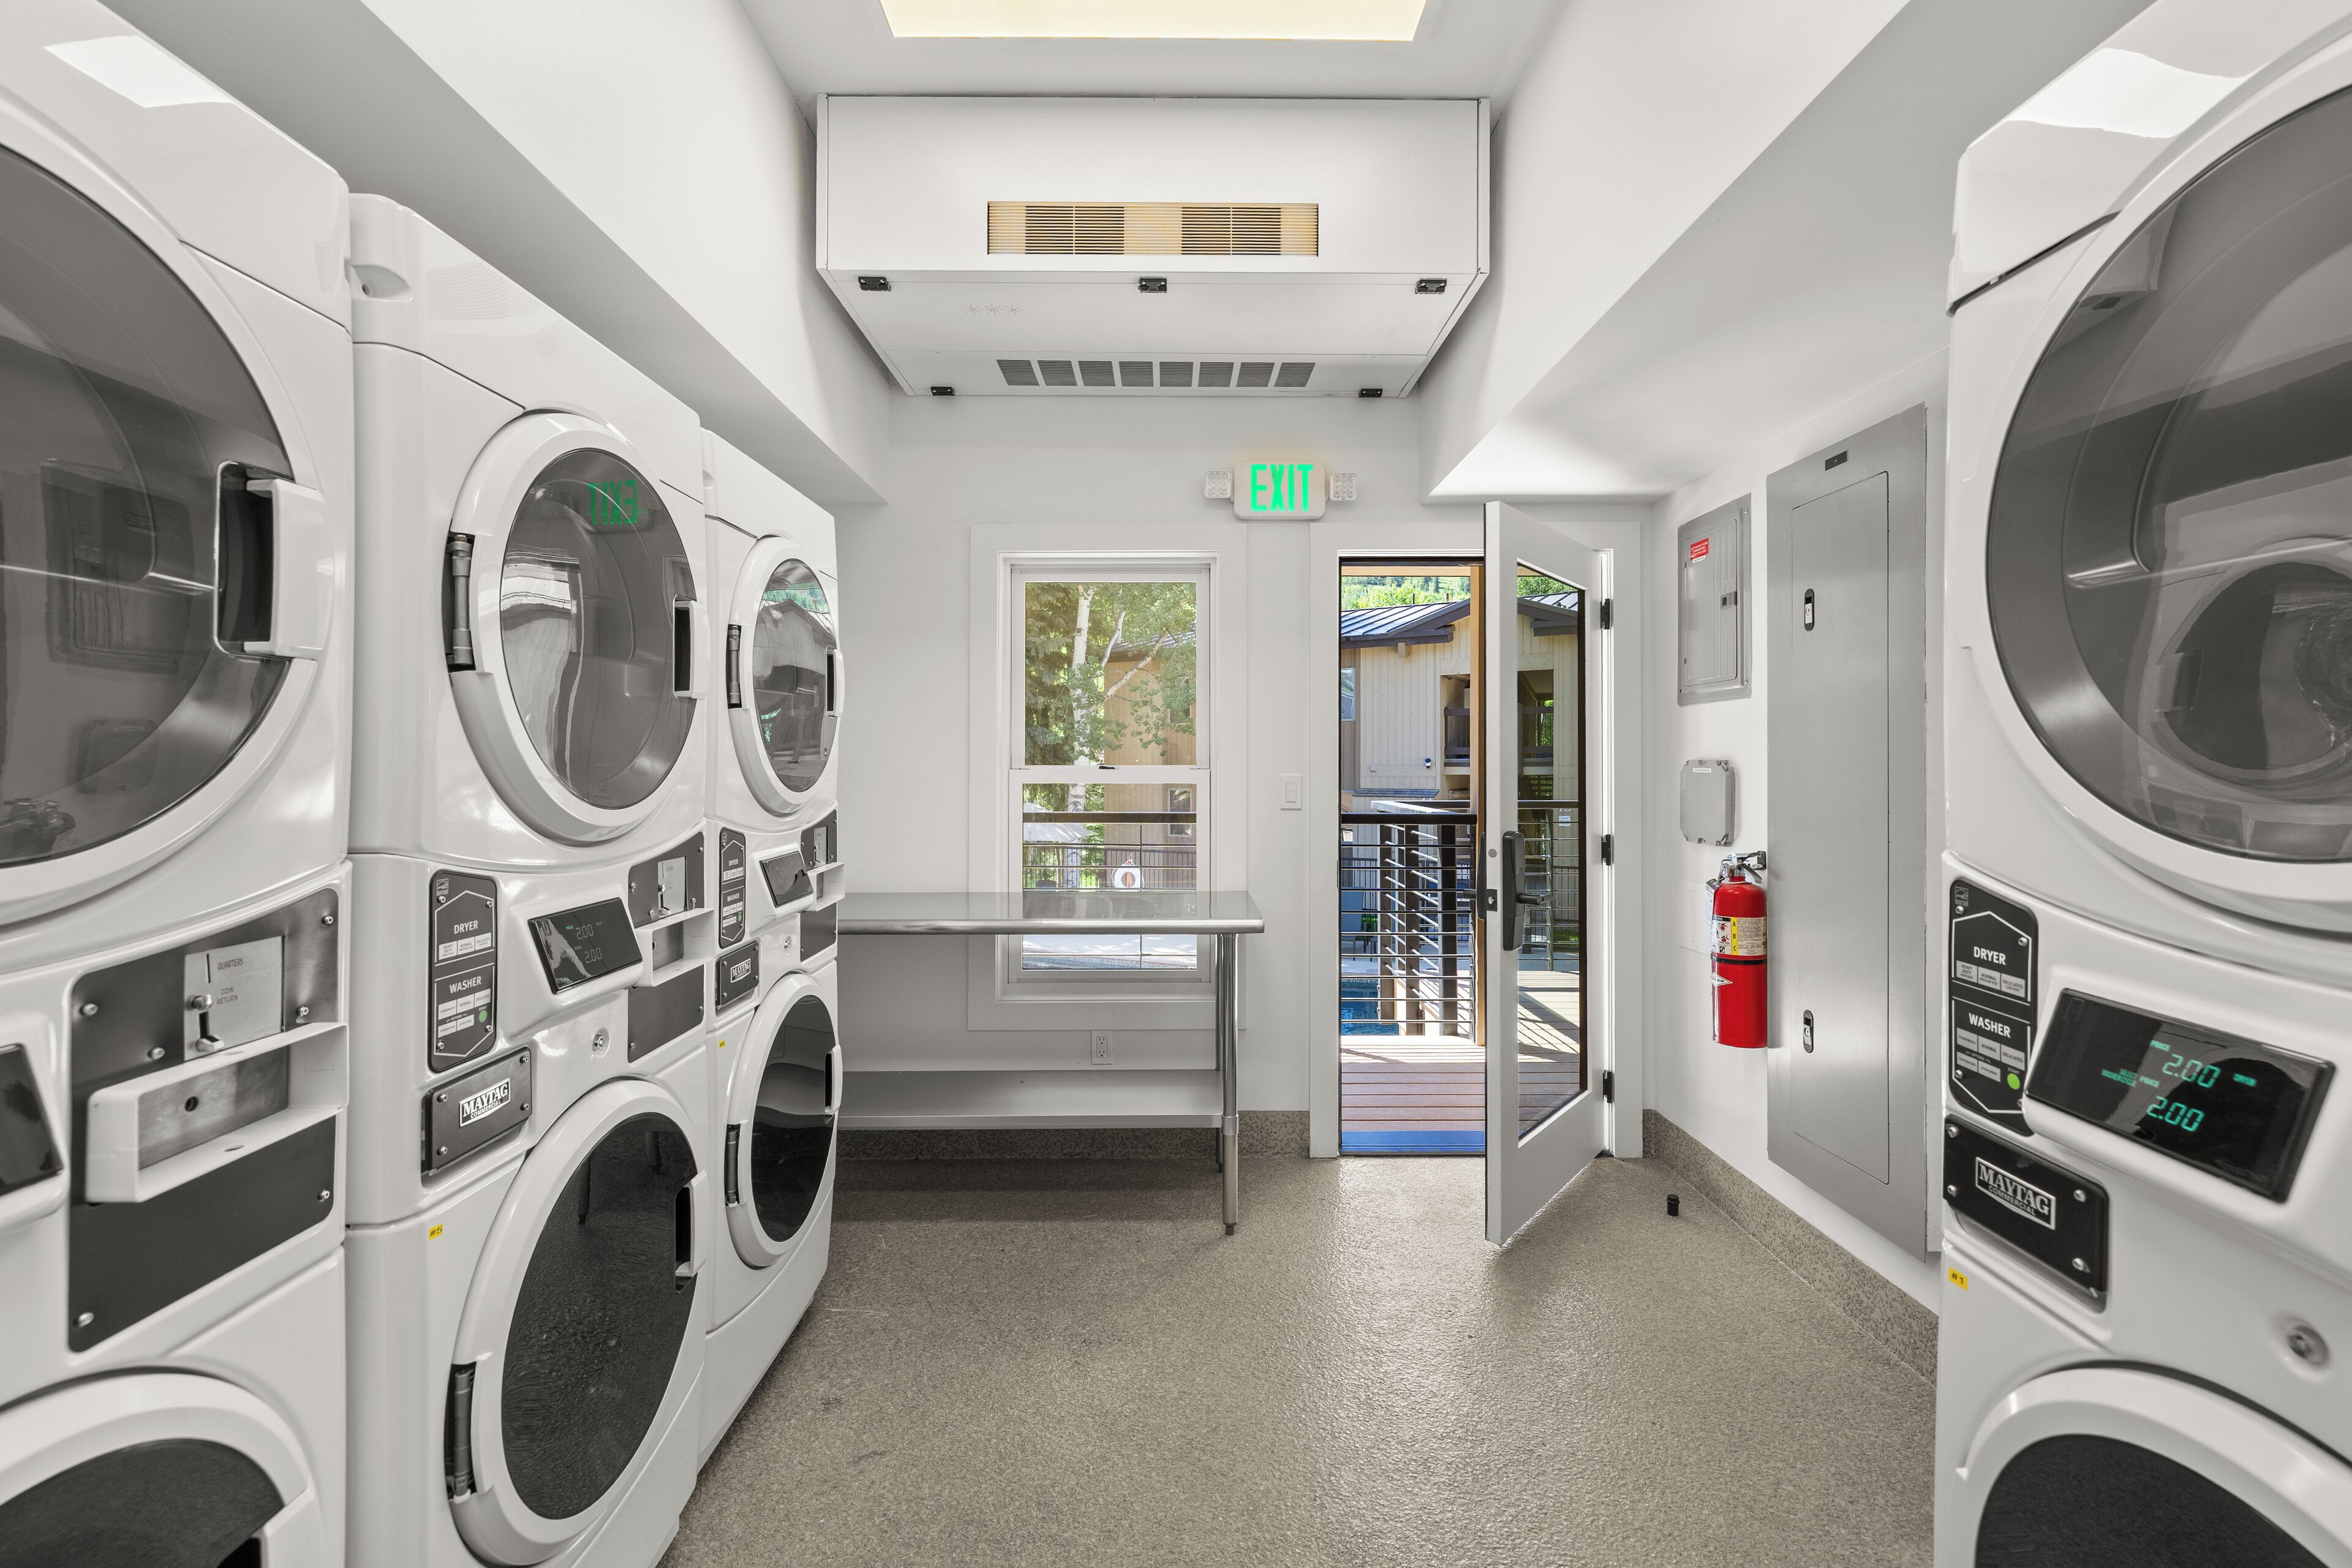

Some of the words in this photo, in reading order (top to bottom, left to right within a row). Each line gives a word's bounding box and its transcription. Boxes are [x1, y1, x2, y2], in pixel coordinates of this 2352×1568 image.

[1251, 464, 1313, 511] EXIT
[727, 893, 740, 902] WASHER
[454, 920, 478, 934] DRYER
[575, 924, 594, 940] 2.00
[584, 948, 602, 963] 2.00
[1973, 946, 2007, 965] DRYER
[217, 957, 244, 970] QUARTERS
[733, 962, 749, 977] MAYTAG
[450, 976, 481, 993] WASHER
[1981, 973, 1997, 981] NORMAL
[2003, 979, 2023, 989] DELICATES
[217, 995, 238, 1005] RETURN
[1969, 1013, 2011, 1038] WASHER
[2003, 1052, 2023, 1063] DELICATES
[2162, 1054, 2221, 1088] 2.00
[2139, 1076, 2160, 1088] PRICE
[463, 1083, 508, 1117] MAYTAG
[470, 1100, 501, 1118] COMMERCIAL
[2146, 1096, 2205, 1132] 2.00
[1979, 1164, 2049, 1215] MAYTAG
[1988, 1185, 2036, 1216] COMMERCIAL
[430, 1226, 442, 1237] #5
